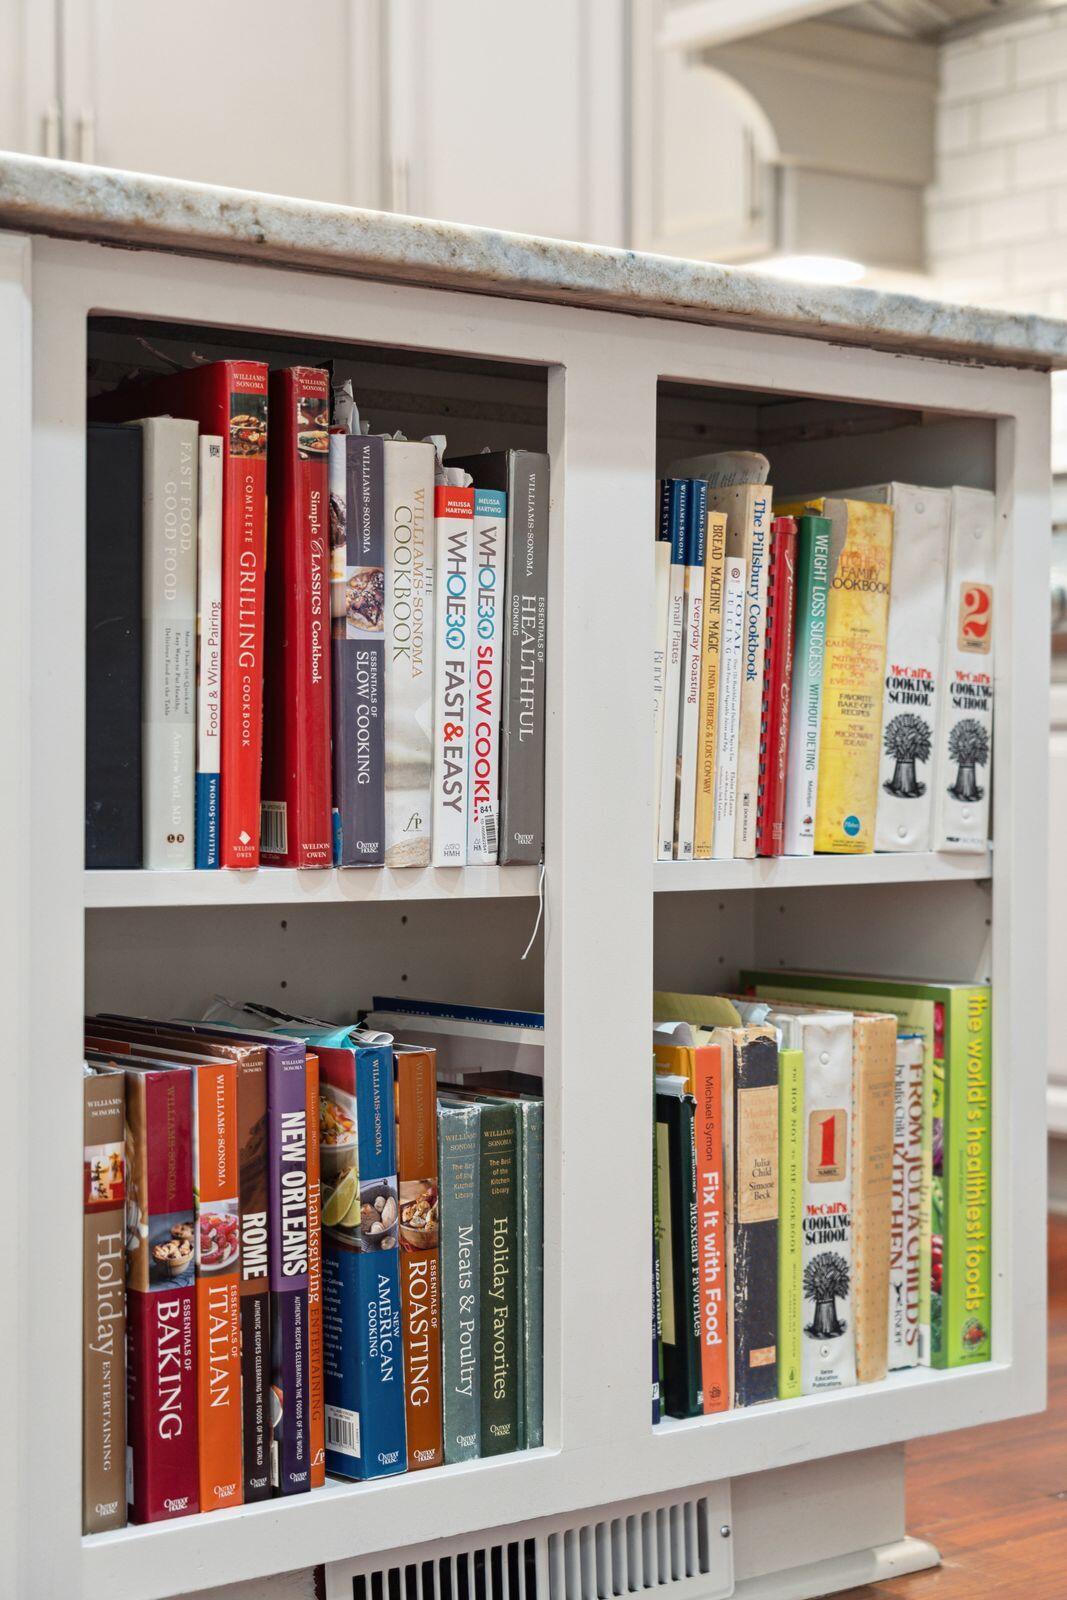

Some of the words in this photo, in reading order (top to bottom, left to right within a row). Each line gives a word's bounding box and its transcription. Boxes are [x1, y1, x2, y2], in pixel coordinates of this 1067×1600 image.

[180, 442, 191, 490] FAST
[164, 482, 176, 540] GOOD
[245, 476, 254, 543] COMPLETE
[308, 490, 320, 534] Simple
[362, 446, 370, 553] WILLIAMS-SONOMA
[754, 500, 766, 527] The
[526, 474, 536, 576] WILLIAMS-SONOMA
[712, 524, 723, 560] BREAD
[164, 548, 176, 600] FOOD
[747, 531, 764, 600] Pillsbury
[814, 535, 828, 581] WEIGHT
[392, 506, 412, 662] COOKBOOK
[412, 488, 424, 678] WILLIAMS-SONOMA
[710, 566, 721, 614] MACHINE
[812, 586, 826, 616] LOSS
[208, 602, 221, 644] Pairing
[240, 550, 256, 668] GRILLING
[674, 596, 682, 626] Small
[690, 598, 702, 650] Everyday
[725, 590, 734, 654] JUICING
[734, 591, 743, 654] TOTAL
[963, 588, 990, 638] 2
[312, 621, 322, 684] Cookbook
[537, 652, 544, 662] OF
[672, 630, 680, 664] Plates
[708, 620, 719, 654] MAGIC
[746, 604, 760, 682] Cookbook
[808, 620, 823, 678] SUCCESS
[208, 651, 218, 685] Wine
[356, 651, 370, 699] SLOW
[370, 651, 378, 703] ESSENTIALS
[476, 646, 492, 716] SLOW
[520, 596, 536, 742] HEALTHFUL
[688, 654, 700, 704] Roasting
[708, 665, 716, 690] LINDA
[886, 676, 934, 692] COOKING
[892, 665, 932, 678] McCall's
[950, 682, 992, 698] COOKING
[956, 671, 990, 684] McCall's
[207, 704, 218, 736] Food
[242, 676, 251, 747] COOKBOOK
[370, 706, 378, 718] OF
[706, 692, 715, 730] REHBERG
[807, 684, 818, 728] WITHOUT
[888, 690, 931, 706] SCHOOL
[953, 696, 989, 712] SCHOOL
[172, 731, 182, 772] Andrew
[356, 704, 370, 785] COOKING
[704, 740, 713, 758] LOIS
[805, 732, 817, 770] DIETING
[474, 722, 492, 824] COOKE
[703, 760, 712, 794] CONWAY
[172, 804, 180, 824] MD
[480, 806, 492, 814] 841
[968, 994, 987, 1033] the
[895, 1064, 905, 1078] by
[895, 1080, 905, 1104] Julia
[967, 1040, 987, 1121] world's
[88, 1098, 122, 1108] WILLIAMS
[92, 1108, 120, 1117] SONOMA
[705, 1076, 714, 1119] Michael
[908, 1063, 922, 1146] FROM
[167, 1086, 177, 1200] WILLIAMS-SONOMA
[217, 1074, 226, 1187] WILLIAMS-SONOMA
[281, 1110, 306, 1161] NEW
[704, 1122, 714, 1161] Symon
[818, 1114, 836, 1166] 1
[895, 1107, 905, 1137] Child
[749, 1182, 774, 1191] Simone
[752, 1168, 772, 1178] Child
[754, 1158, 770, 1168] Julia
[966, 1128, 987, 1240] healthiest
[702, 1170, 719, 1205] Fix
[806, 1202, 848, 1215] McCall's
[890, 1142, 905, 1269] KITCHEN
[901, 1151, 922, 1232] JULIA
[282, 1170, 307, 1276] ORLEANS
[308, 1180, 321, 1304] Thanksgiving
[690, 1202, 700, 1265] Mexican
[704, 1210, 719, 1227] It
[802, 1214, 851, 1231] COOKING
[805, 1229, 848, 1245] SCHOOL
[242, 1211, 268, 1280] ROME
[458, 1226, 474, 1288] Meats
[488, 1216, 508, 1302] Holiday
[703, 1232, 720, 1282] with
[90, 1230, 122, 1355] Holiday
[692, 1267, 702, 1337] Favorites
[965, 1245, 986, 1312] foods
[254, 1300, 262, 1330] AUTHENTIC
[431, 1317, 437, 1328] OF
[460, 1294, 475, 1313] &
[706, 1288, 722, 1345] Food
[894, 1310, 902, 1345] KNOPF
[209, 1284, 230, 1407] ITALIAN
[231, 1346, 238, 1358] OF
[254, 1331, 262, 1354] RECIPES
[368, 1301, 378, 1357] COOKING
[379, 1274, 393, 1382] AMERICAN
[409, 1259, 429, 1407] ROASTING
[493, 1305, 509, 1399] Favorites
[157, 1299, 182, 1440] BAKING
[184, 1358, 191, 1371] OF
[255, 1355, 263, 1392] CELEBRATING
[311, 1308, 321, 1421] ENTERTAINING
[455, 1318, 476, 1396] Poultry
[103, 1361, 111, 1471] ENTERTAINING
[296, 1420, 303, 1428] OF
